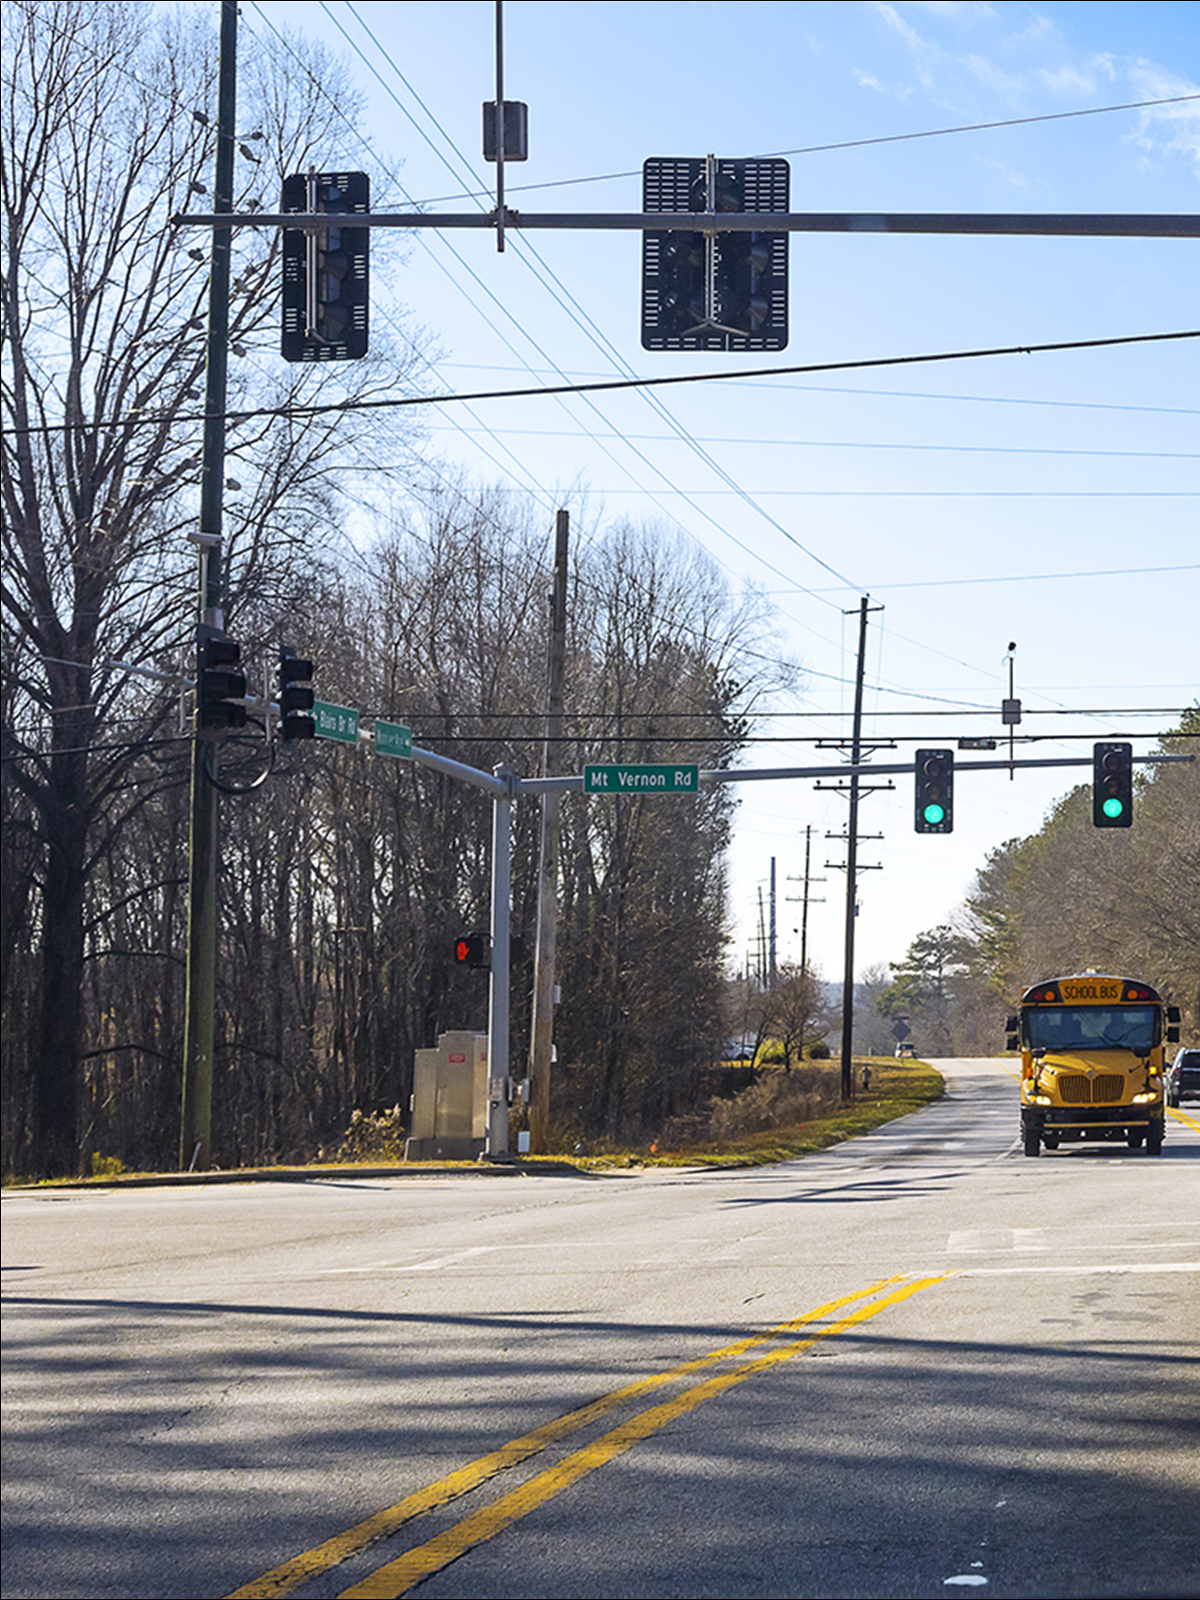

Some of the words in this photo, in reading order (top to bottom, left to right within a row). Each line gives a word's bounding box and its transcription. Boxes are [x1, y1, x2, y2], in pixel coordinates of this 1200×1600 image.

[591, 771, 608, 786] Mt
[618, 771, 666, 786] Vernon
[674, 771, 692, 786] Rd
[1064, 985, 1099, 1000] SCHOOL
[1100, 985, 1118, 999] BUS
